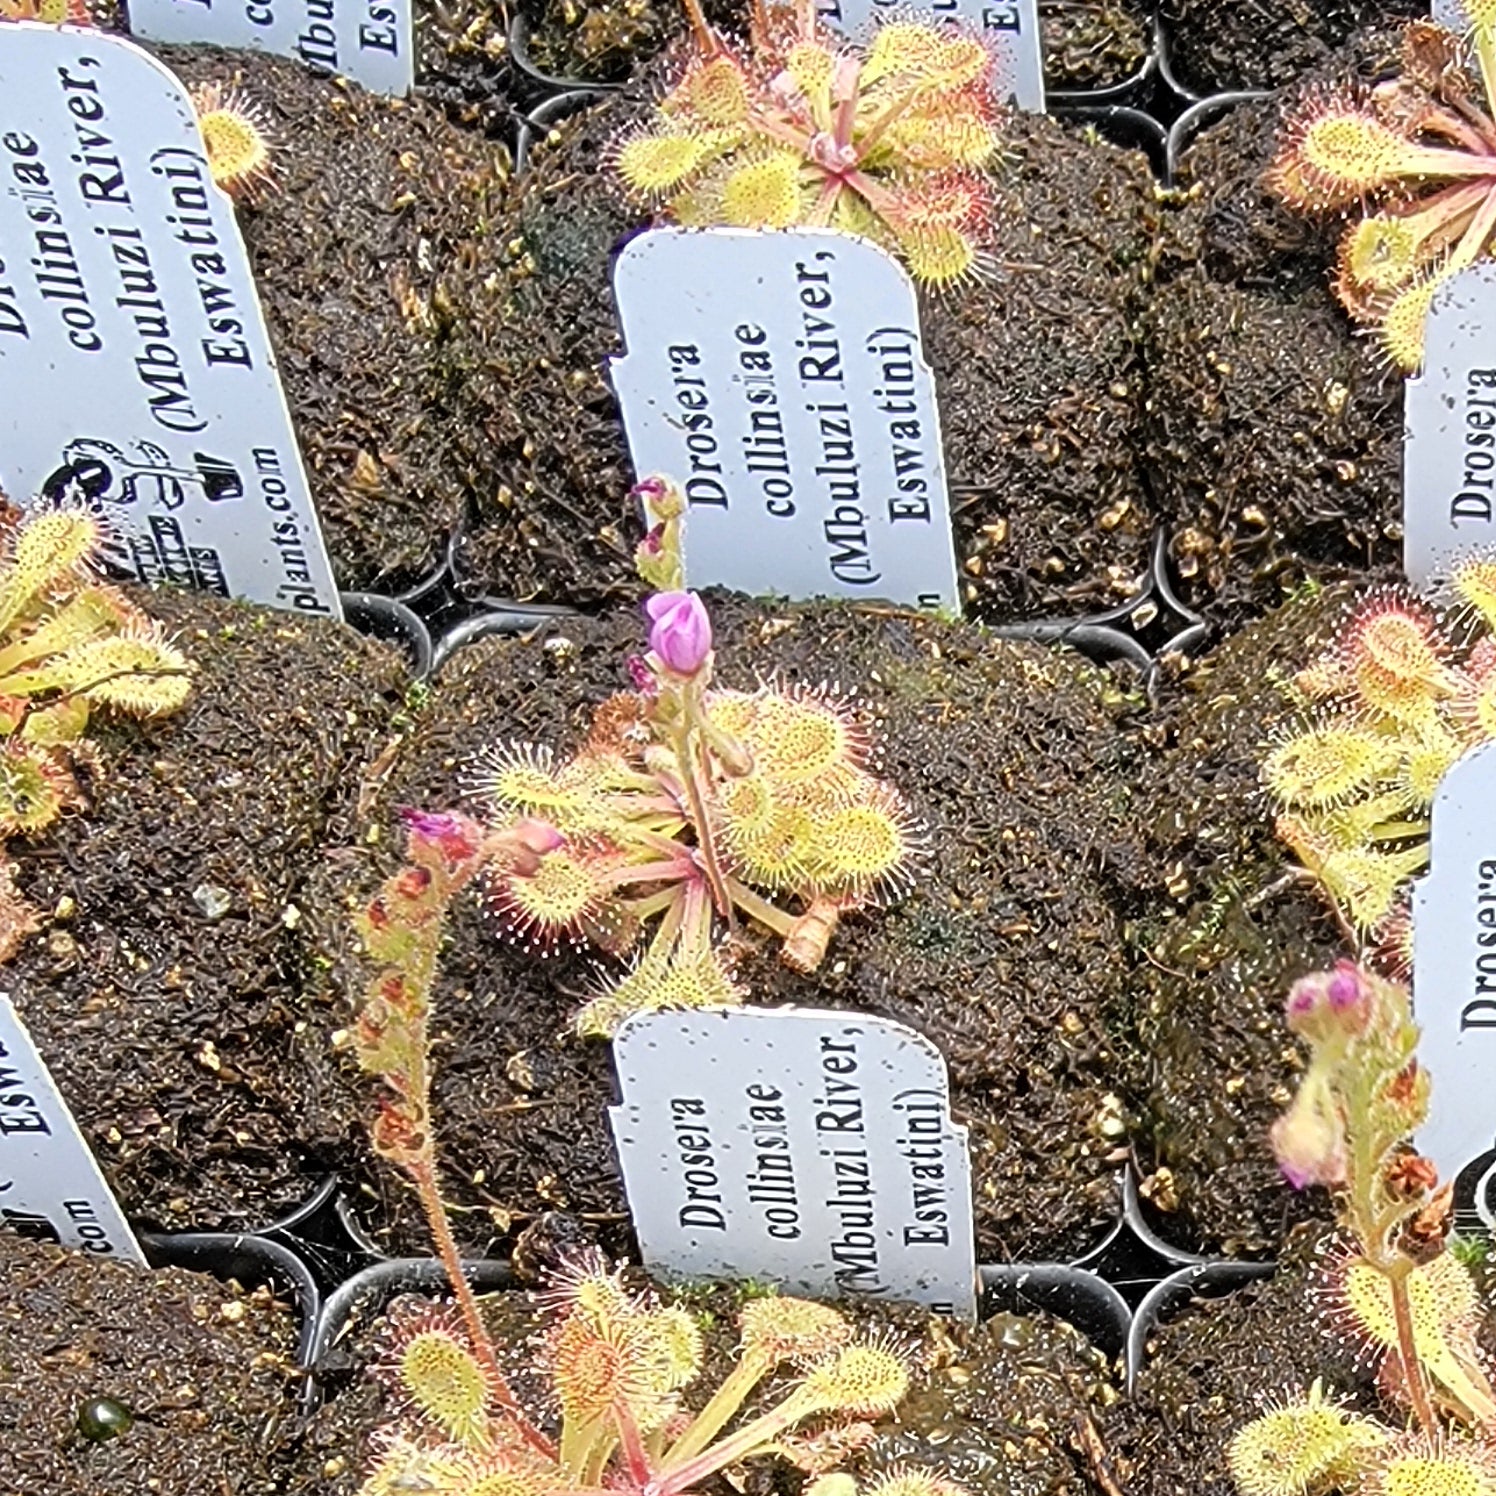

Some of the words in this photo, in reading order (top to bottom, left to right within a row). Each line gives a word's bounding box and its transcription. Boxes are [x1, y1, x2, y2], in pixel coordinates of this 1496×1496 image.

[57, 56, 133, 206] River,
[95, 227, 208, 432] (Mbuluzi
[150, 148, 252, 370] Eswatini)
[795, 251, 845, 387] River,
[668, 343, 729, 511] Drosera
[806, 404, 881, 585] (Mbuluzi
[866, 327, 931, 524] Eswatini)
[813, 1026, 865, 1137] River,
[670, 1098, 726, 1232] Drosera
[821, 1150, 890, 1293] (Mbuluzi
[892, 1088, 949, 1247] Eswatini)
